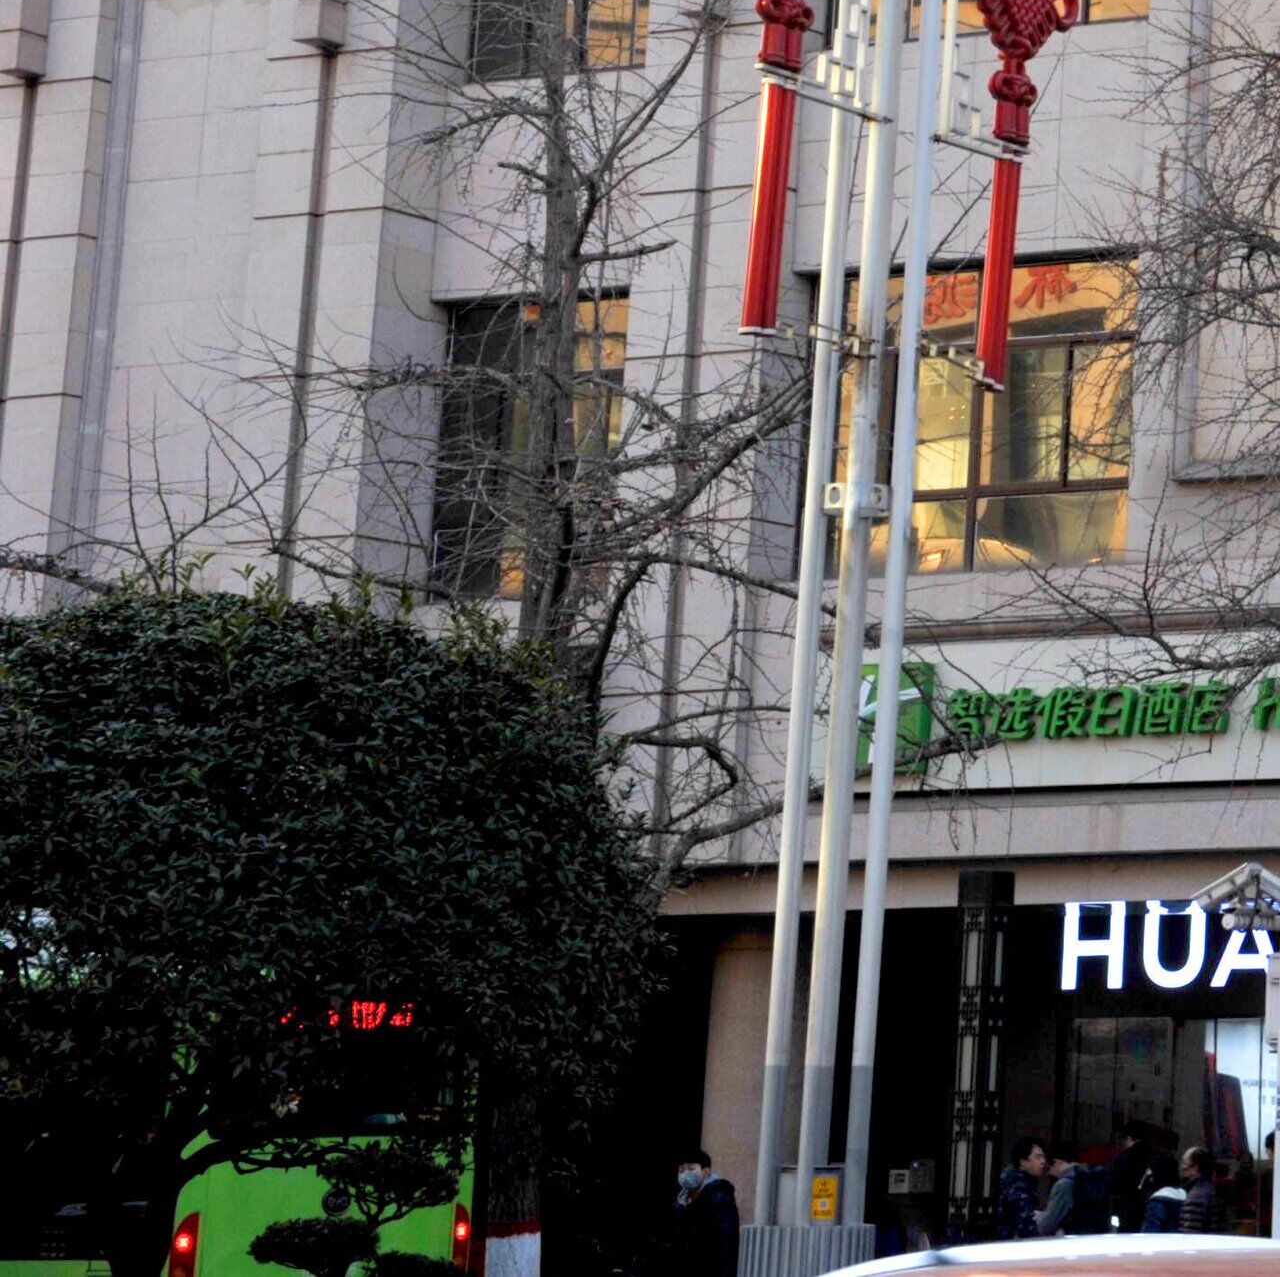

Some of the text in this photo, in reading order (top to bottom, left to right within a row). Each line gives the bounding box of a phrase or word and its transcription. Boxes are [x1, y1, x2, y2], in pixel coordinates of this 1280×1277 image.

[945, 680, 1233, 741] 智选假日酒店
